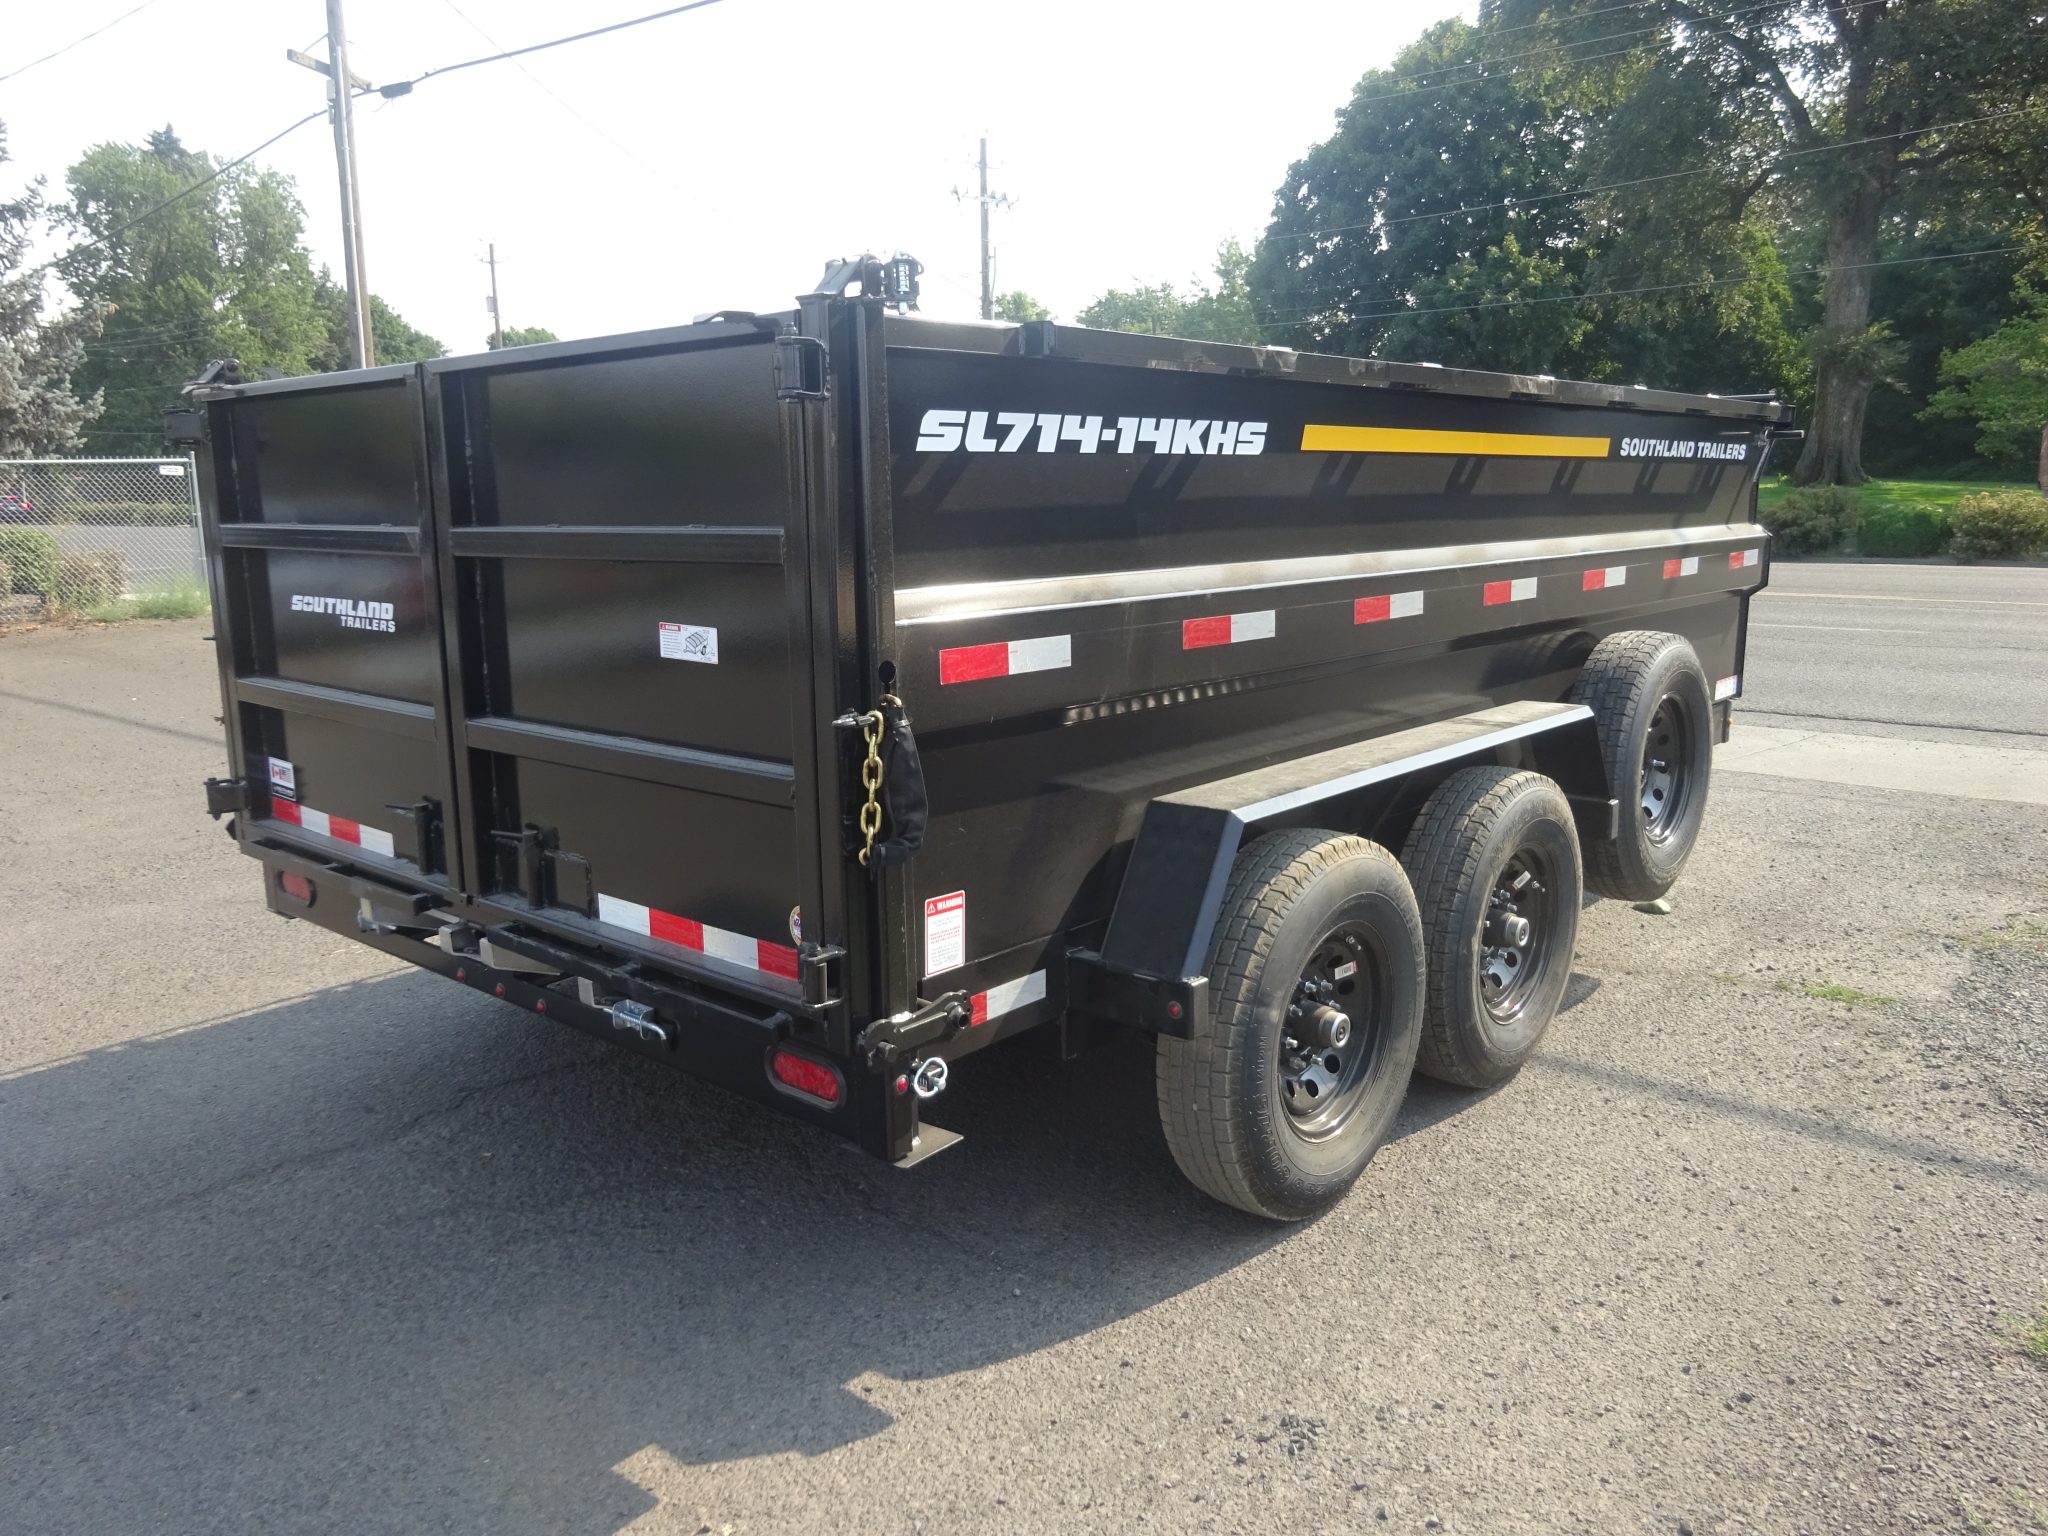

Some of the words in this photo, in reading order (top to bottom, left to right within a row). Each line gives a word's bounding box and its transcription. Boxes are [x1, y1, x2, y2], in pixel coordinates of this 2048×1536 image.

[915, 409, 1268, 455] SL714-14KHS
[1620, 437, 1695, 458] SOUTHLAND
[1697, 441, 1747, 460] TRAILERS
[291, 594, 394, 620] SOUTHLAND
[340, 615, 396, 632] TRAILERS
